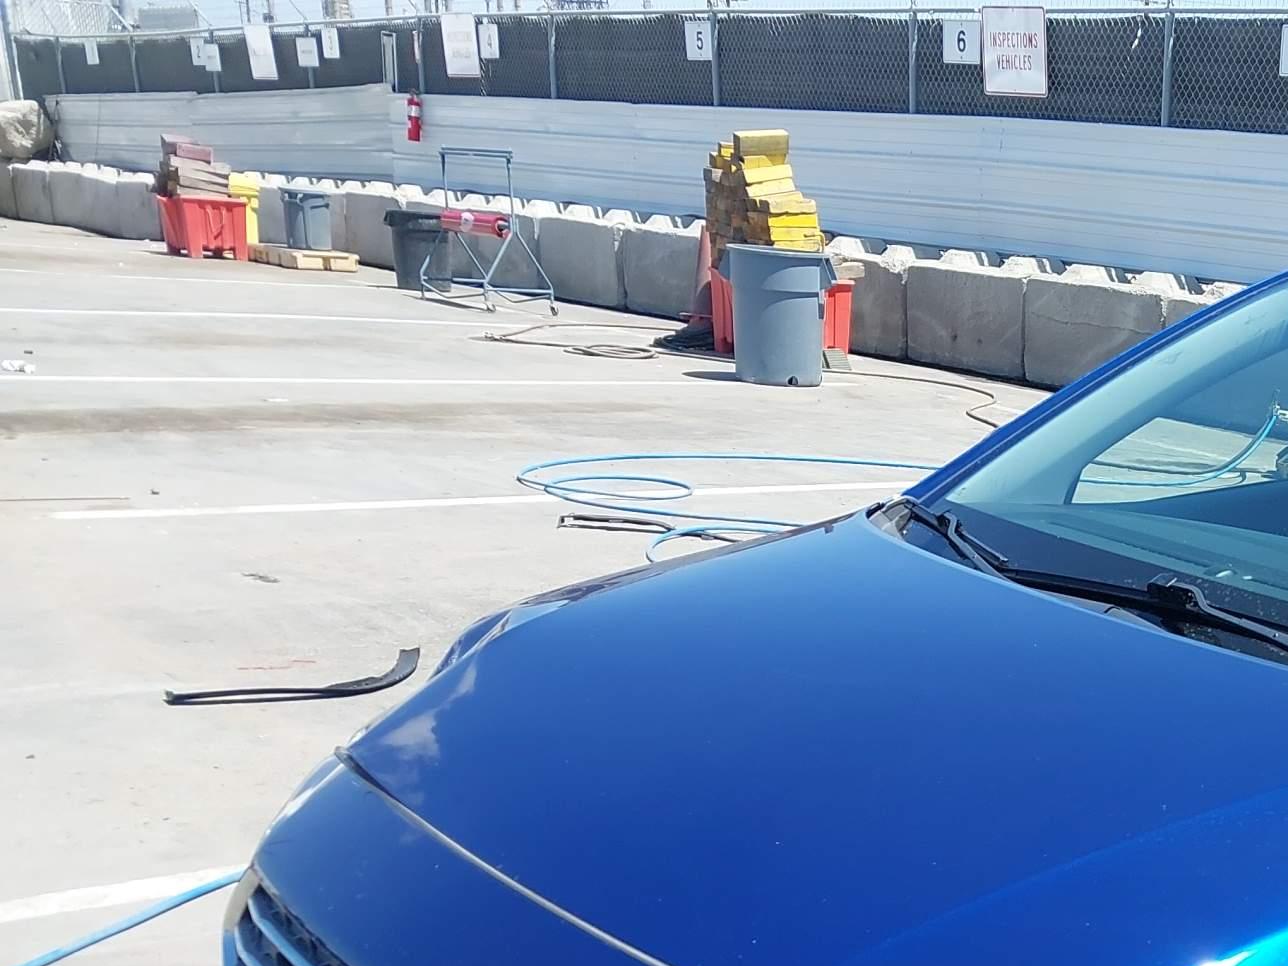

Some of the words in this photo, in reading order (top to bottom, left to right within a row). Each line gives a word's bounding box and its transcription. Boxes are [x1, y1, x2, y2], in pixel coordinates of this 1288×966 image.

[486, 33, 493, 49] 4
[696, 31, 704, 50] 5
[956, 30, 967, 52] 6
[989, 31, 1039, 49] INSPECTIONS
[996, 54, 1033, 71] VEHICLES
